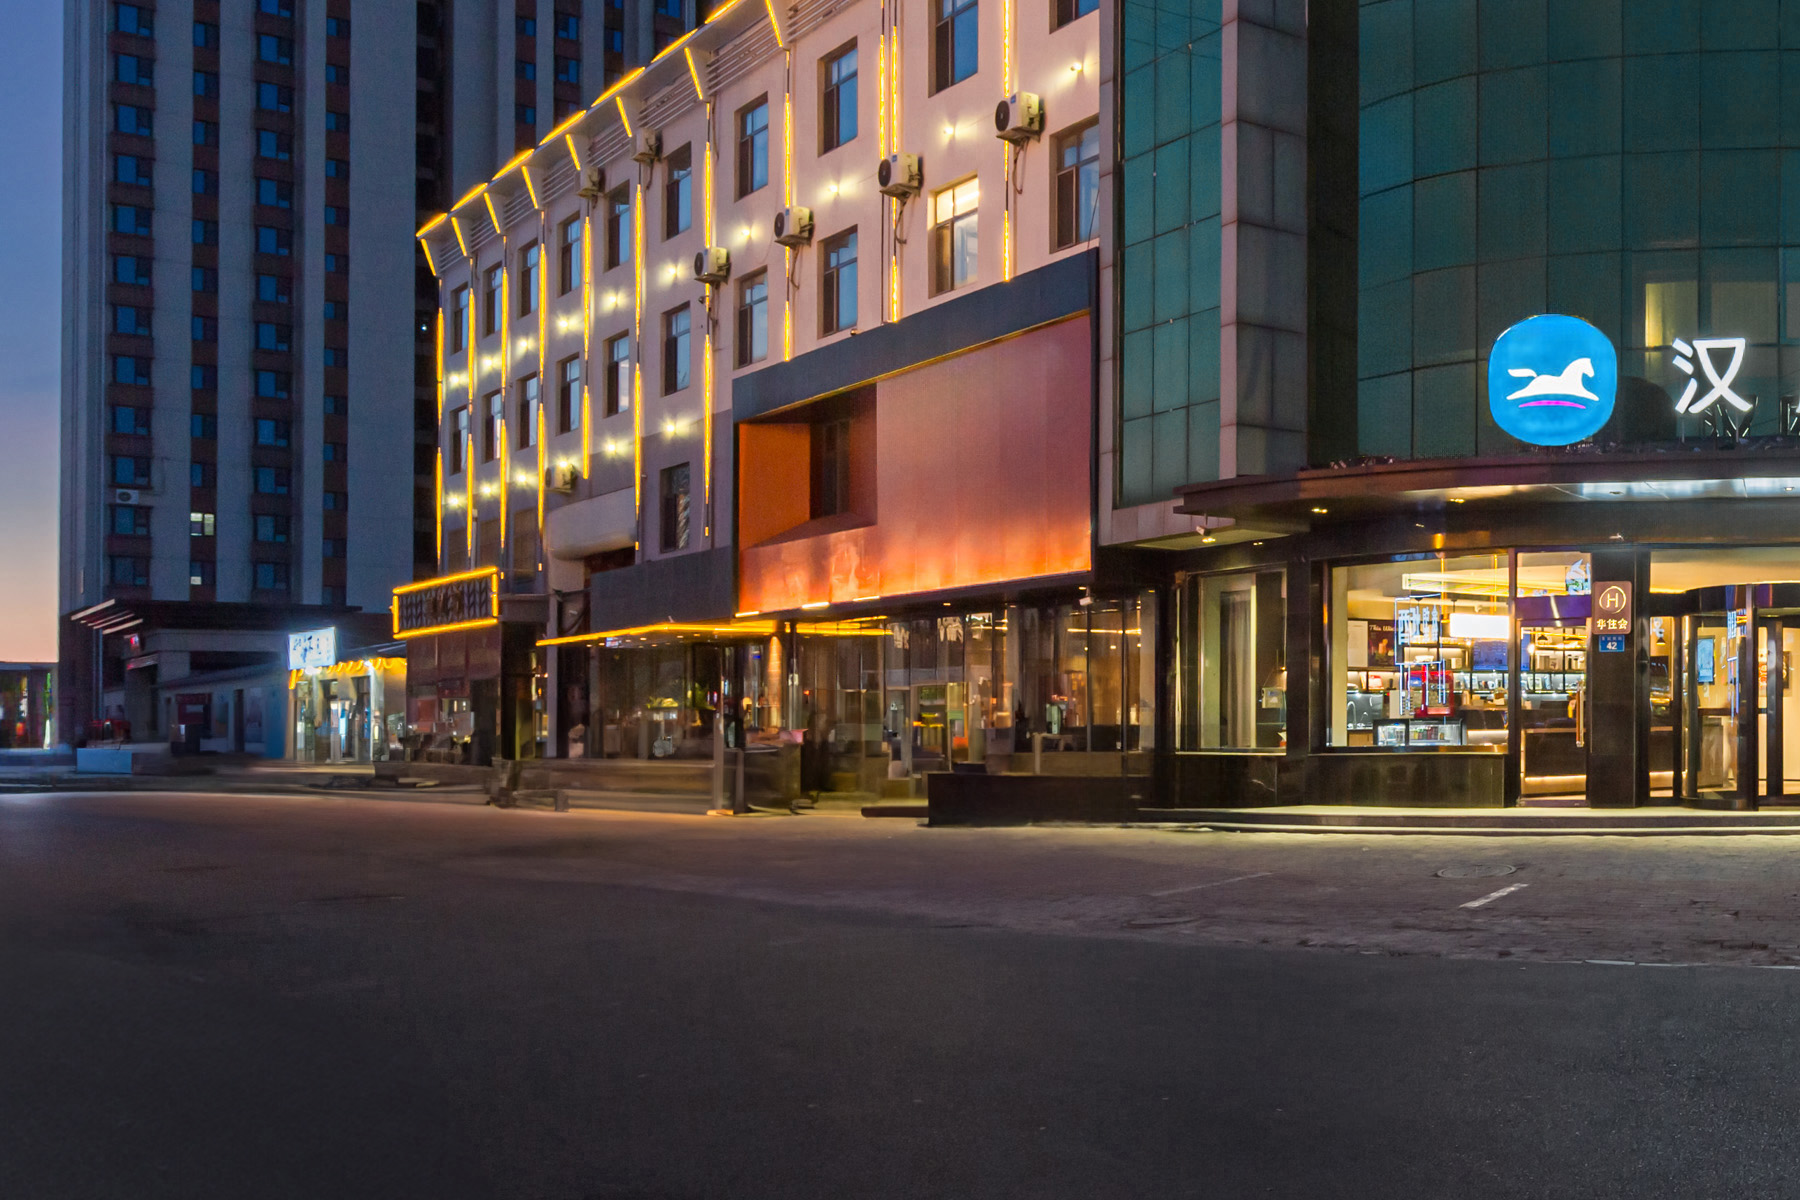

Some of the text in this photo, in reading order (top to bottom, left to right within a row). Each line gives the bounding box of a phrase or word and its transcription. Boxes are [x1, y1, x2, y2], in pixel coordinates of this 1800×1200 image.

[1605, 591, 1618, 608] H
[1596, 618, 1628, 630] 华住会
[1606, 641, 1617, 650] 42
